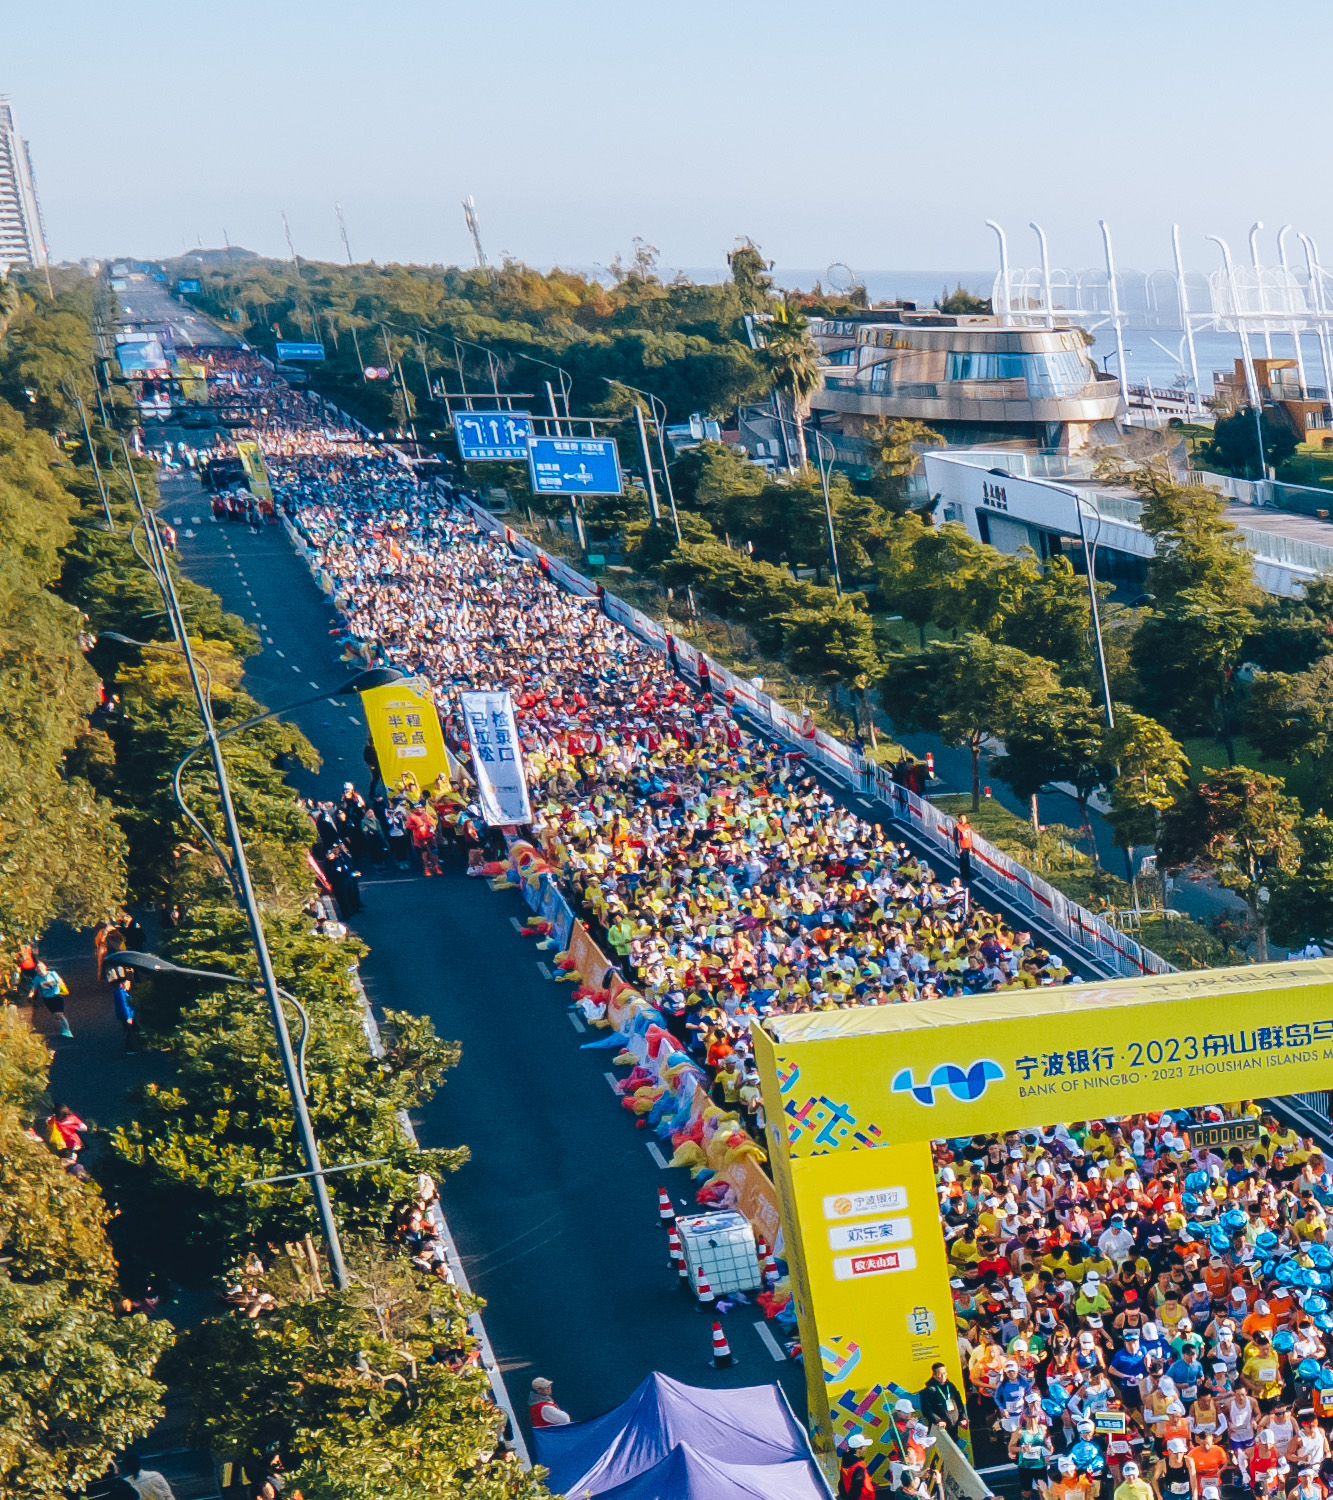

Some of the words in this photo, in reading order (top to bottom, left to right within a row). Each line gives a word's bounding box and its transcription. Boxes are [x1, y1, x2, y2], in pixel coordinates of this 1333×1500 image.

[387, 712, 422, 728] 半程
[391, 731, 426, 745] 起点
[471, 711, 495, 762] 马拉松
[492, 710, 515, 762] 检录口
[1018, 1081, 1057, 1098] BANK
[1060, 1078, 1080, 1093] OF
[1083, 1072, 1140, 1090] NINGBO
[1151, 1066, 1184, 1082] 2023
[1187, 1056, 1262, 1077] ZHOUSHAN
[1265, 1050, 1319, 1068] ISLANDS
[1194, 1124, 1256, 1146] 0:00:02
[854, 1191, 898, 1207] 宁波银行
[848, 1223, 894, 1242] 欢乐家
